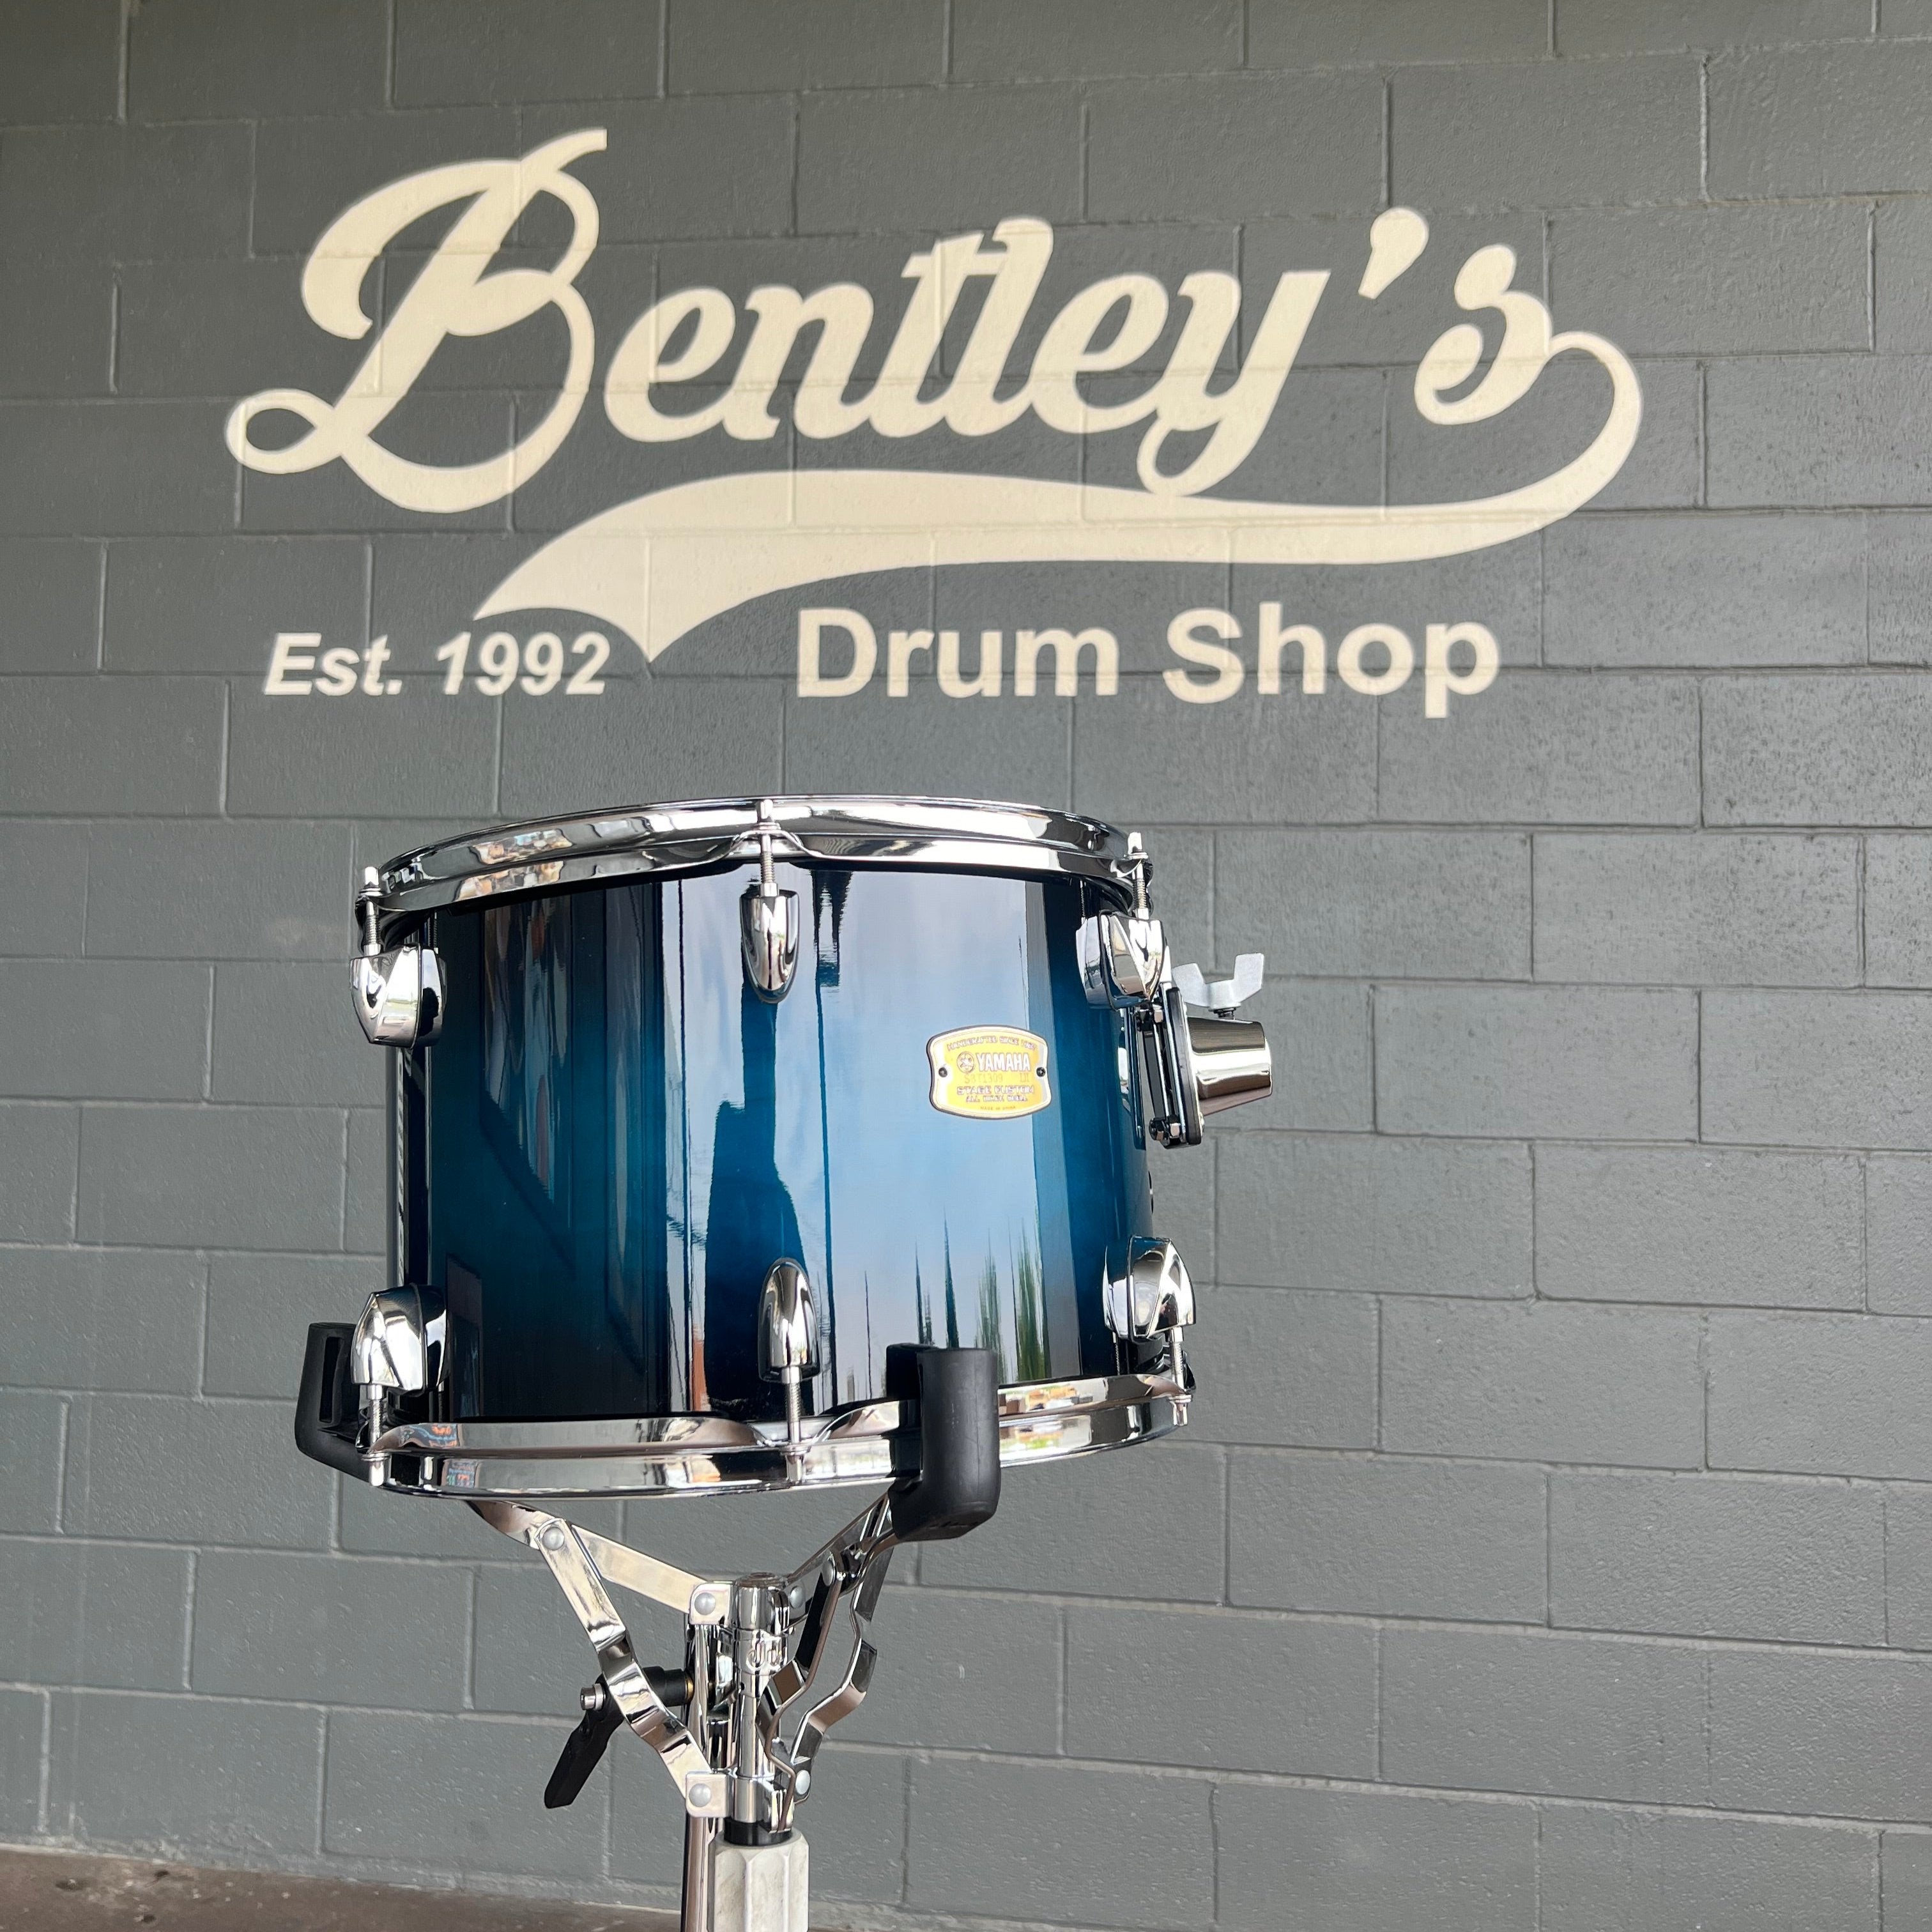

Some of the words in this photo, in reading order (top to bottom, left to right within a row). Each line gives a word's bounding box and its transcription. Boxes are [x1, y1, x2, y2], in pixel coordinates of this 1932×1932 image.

[226, 128, 1552, 513] Bentley's
[263, 632, 404, 696] Est.
[436, 632, 611, 696] 1992
[796, 607, 1119, 699] Drum
[1162, 601, 1501, 719] Shop
[956, 1085, 992, 1096] STAGE
[993, 1085, 1035, 1095] CUSTOM
[976, 1052, 1031, 1072] YAMAHA
